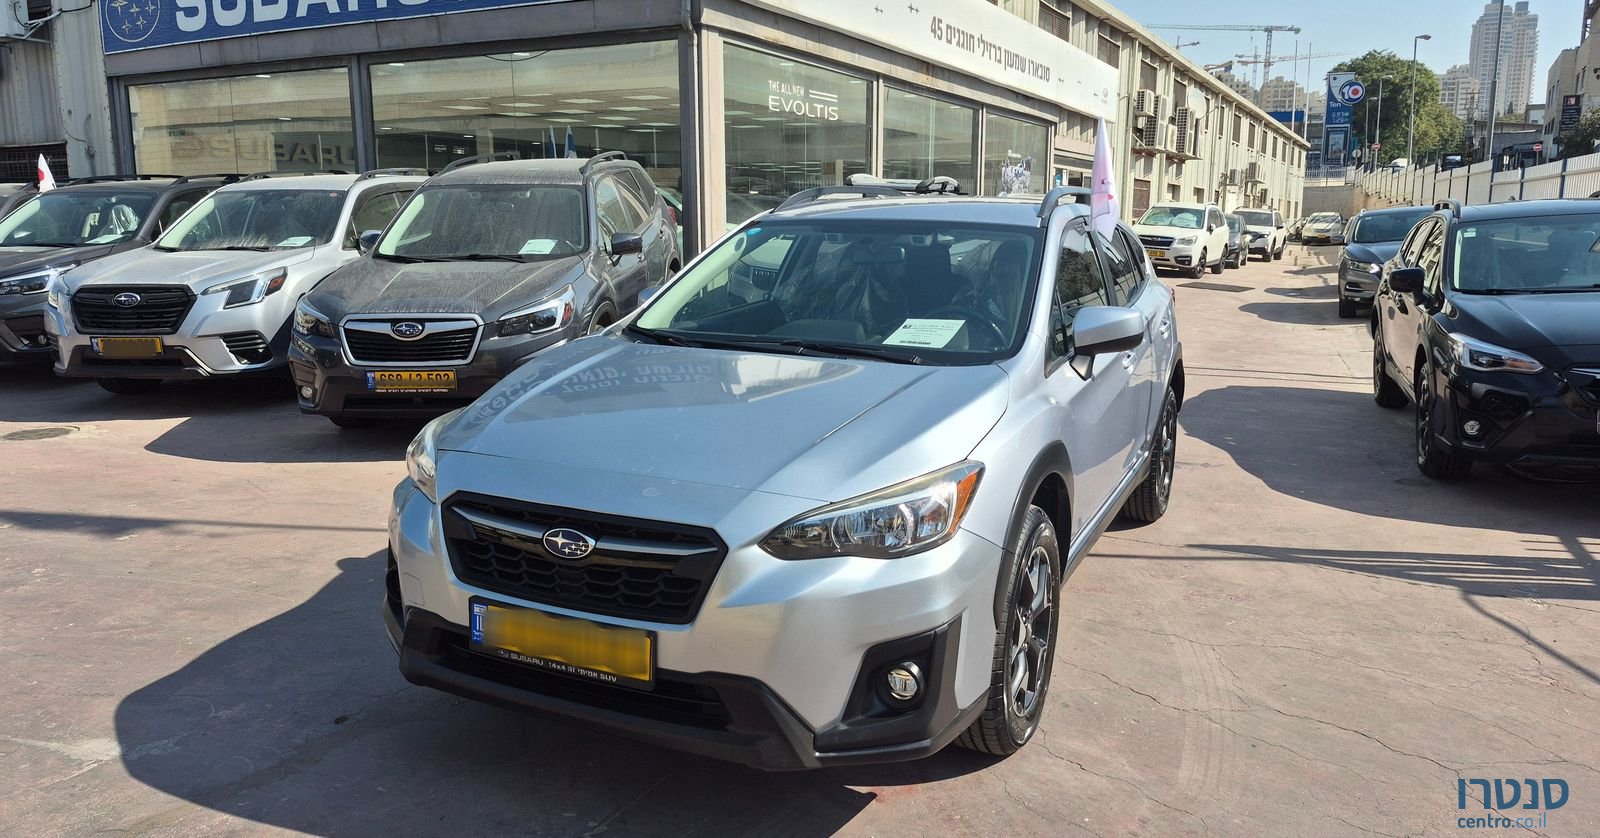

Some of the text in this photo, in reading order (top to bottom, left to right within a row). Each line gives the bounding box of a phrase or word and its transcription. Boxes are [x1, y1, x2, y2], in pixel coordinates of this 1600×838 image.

[175, 0, 430, 32] SUB
[930, 16, 1051, 82] סובארו שמעון ברזילי חוגגים 45
[768, 80, 805, 97] THE ALL NEW
[768, 95, 839, 120] EVOLTIS
[510, 652, 544, 665] SUBARU
[600, 673, 617, 682] SUV
